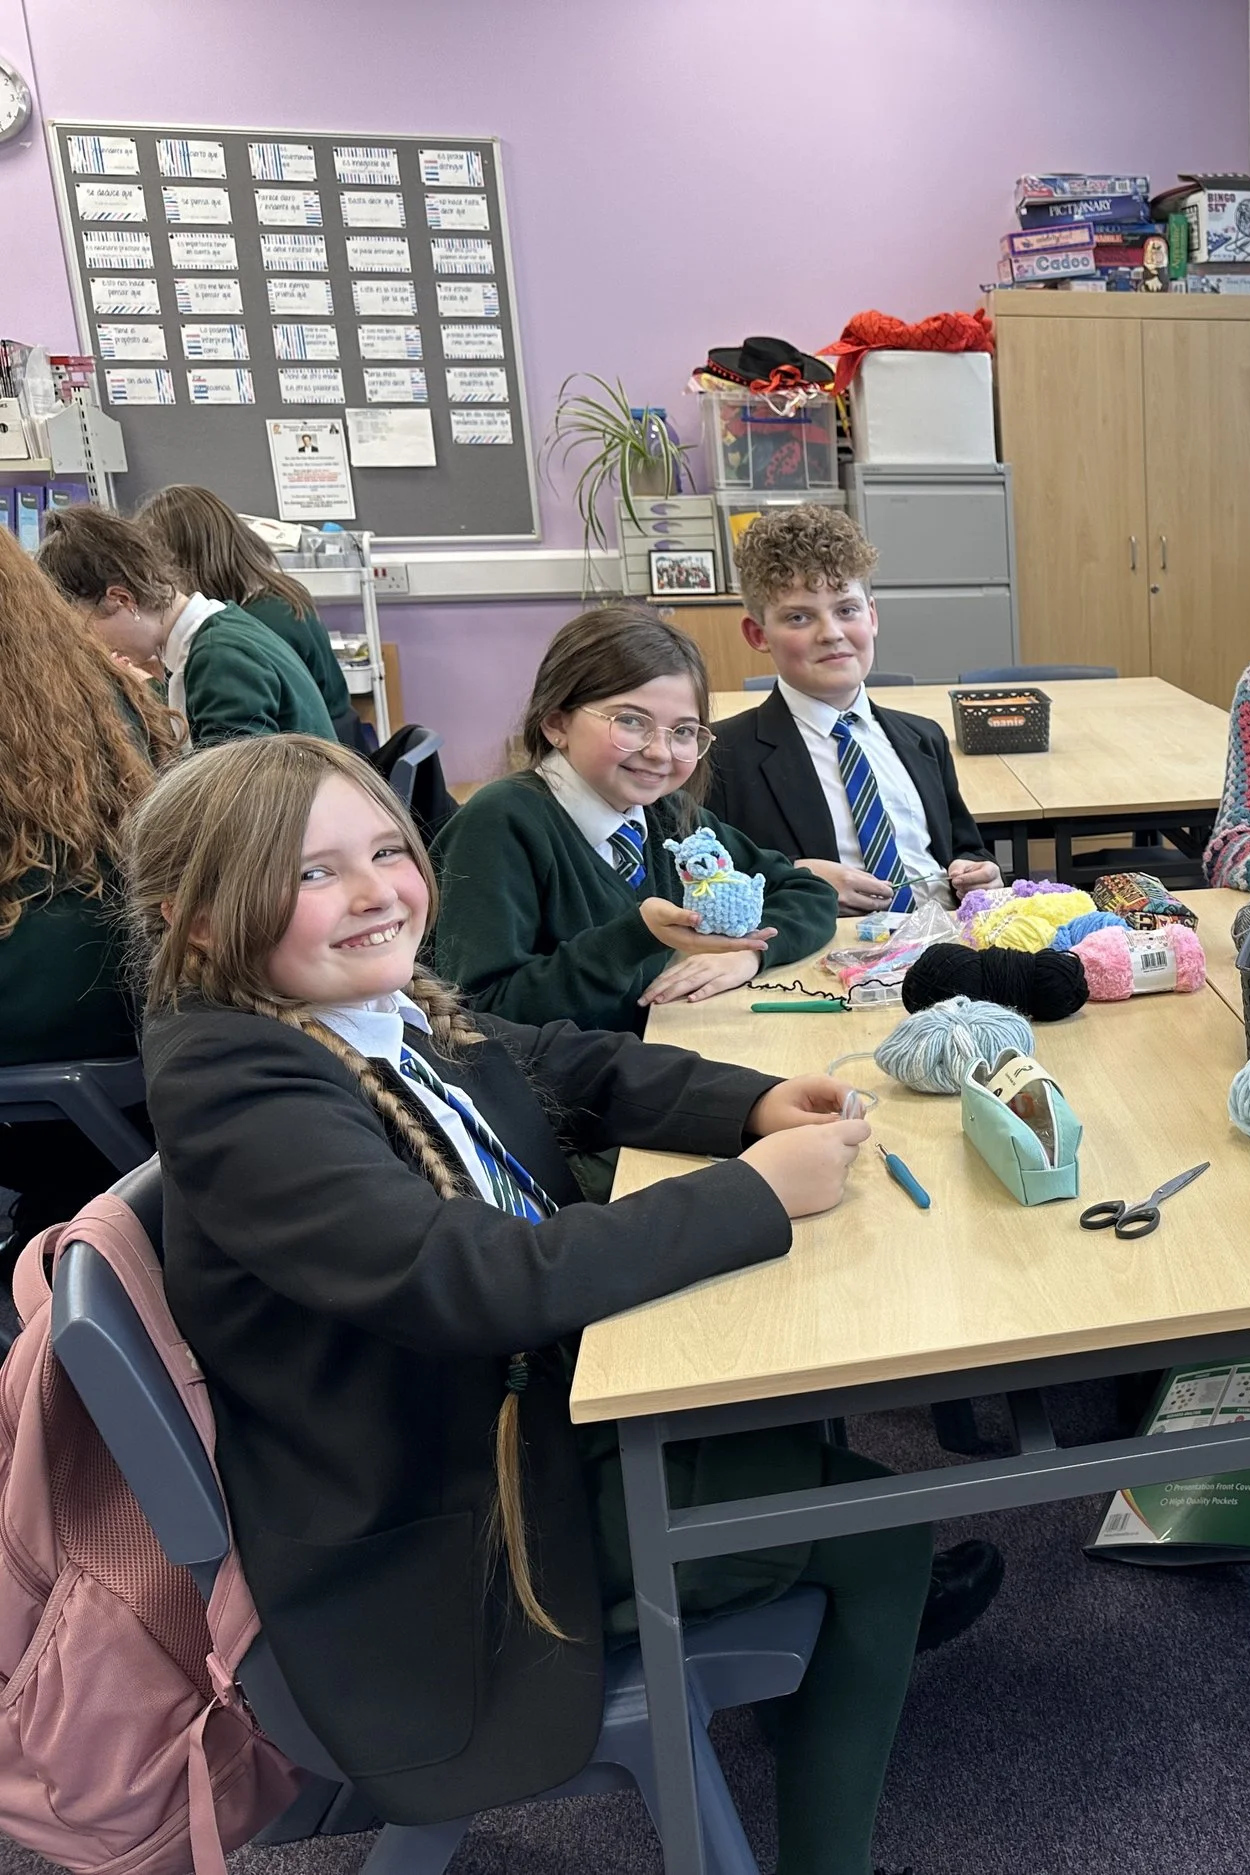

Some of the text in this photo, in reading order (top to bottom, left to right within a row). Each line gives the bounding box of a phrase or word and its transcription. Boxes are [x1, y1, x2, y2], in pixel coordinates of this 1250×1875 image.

[4, 78, 9, 86] 2
[10, 94, 16, 102] 3
[1207, 193, 1236, 203] BINGO
[1207, 204, 1227, 213] SET
[1036, 254, 1090, 271] Cadoo
[1216, 1482, 1234, 1490] Front
[1169, 1497, 1239, 1507] High Quality Pockets
